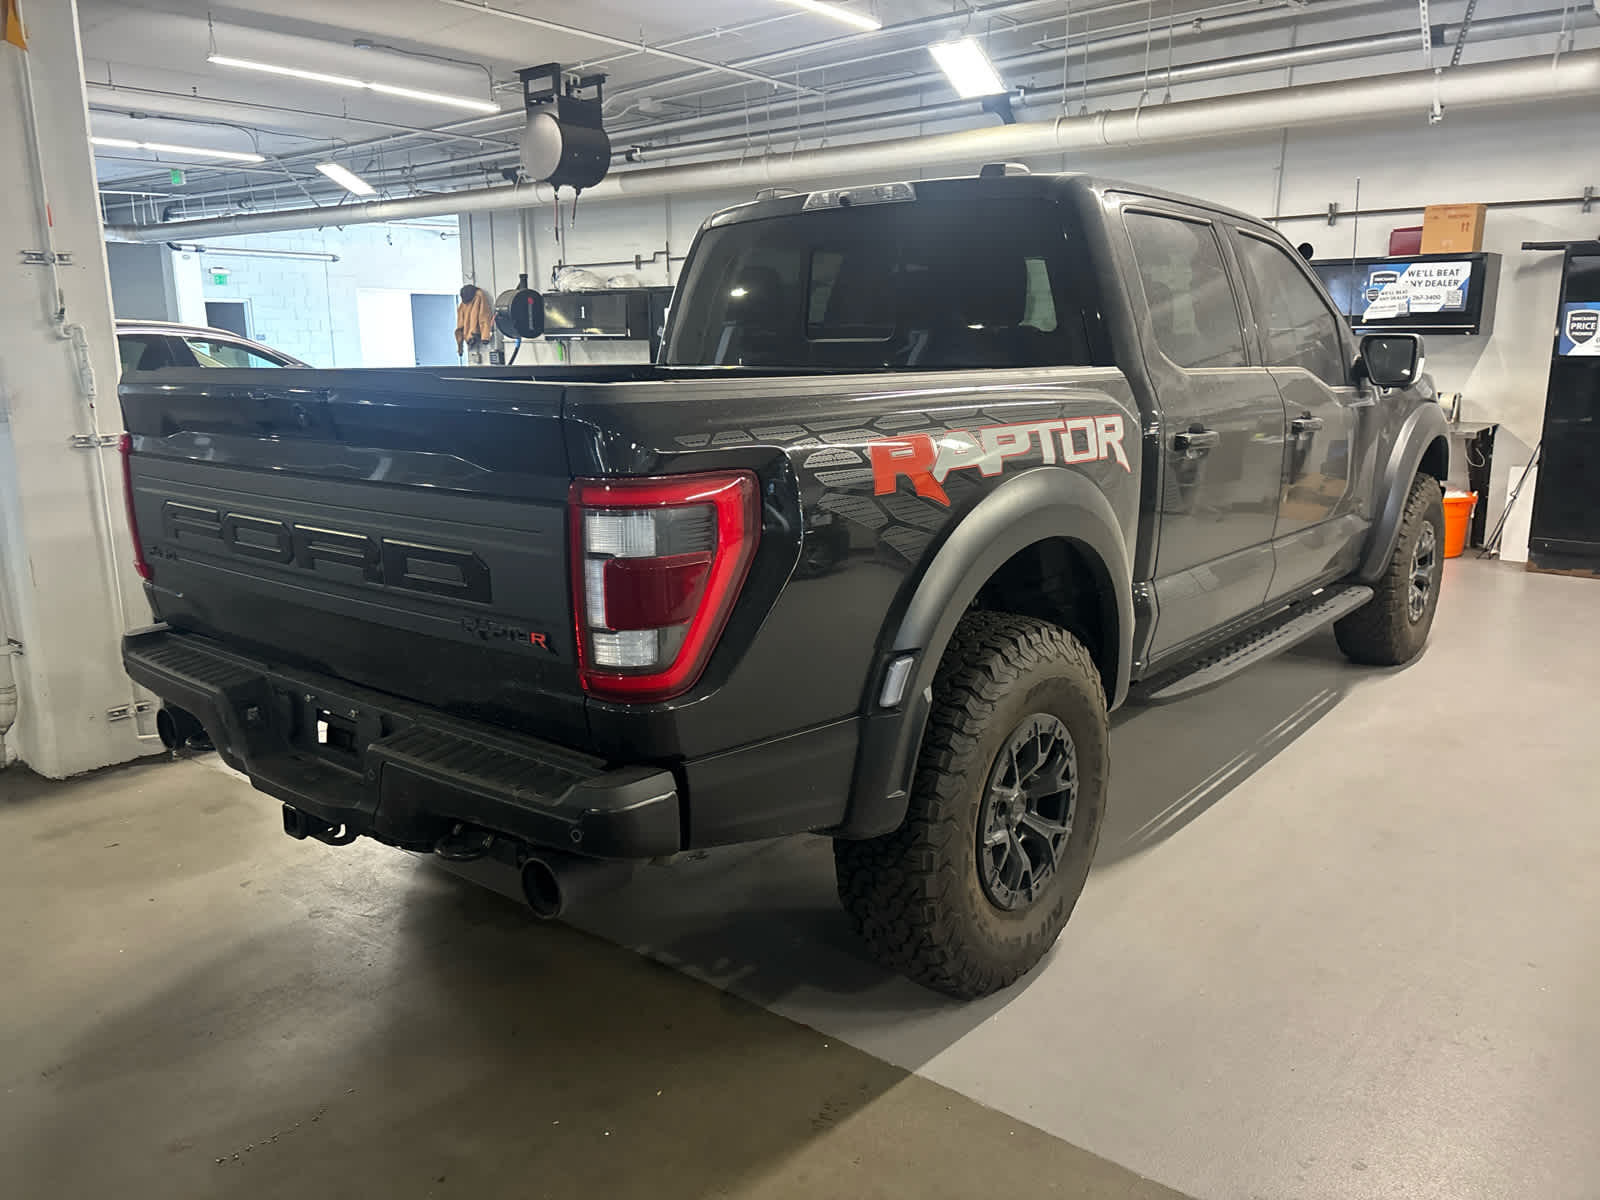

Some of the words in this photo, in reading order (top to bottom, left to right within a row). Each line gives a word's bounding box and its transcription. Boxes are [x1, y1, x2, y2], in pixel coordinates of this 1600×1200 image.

[1408, 269, 1434, 277] WE'LL
[1437, 269, 1460, 277] BEAT
[1570, 322, 1596, 330] PRICE
[867, 414, 1131, 507] RAPTOR
[163, 501, 493, 603] FORD
